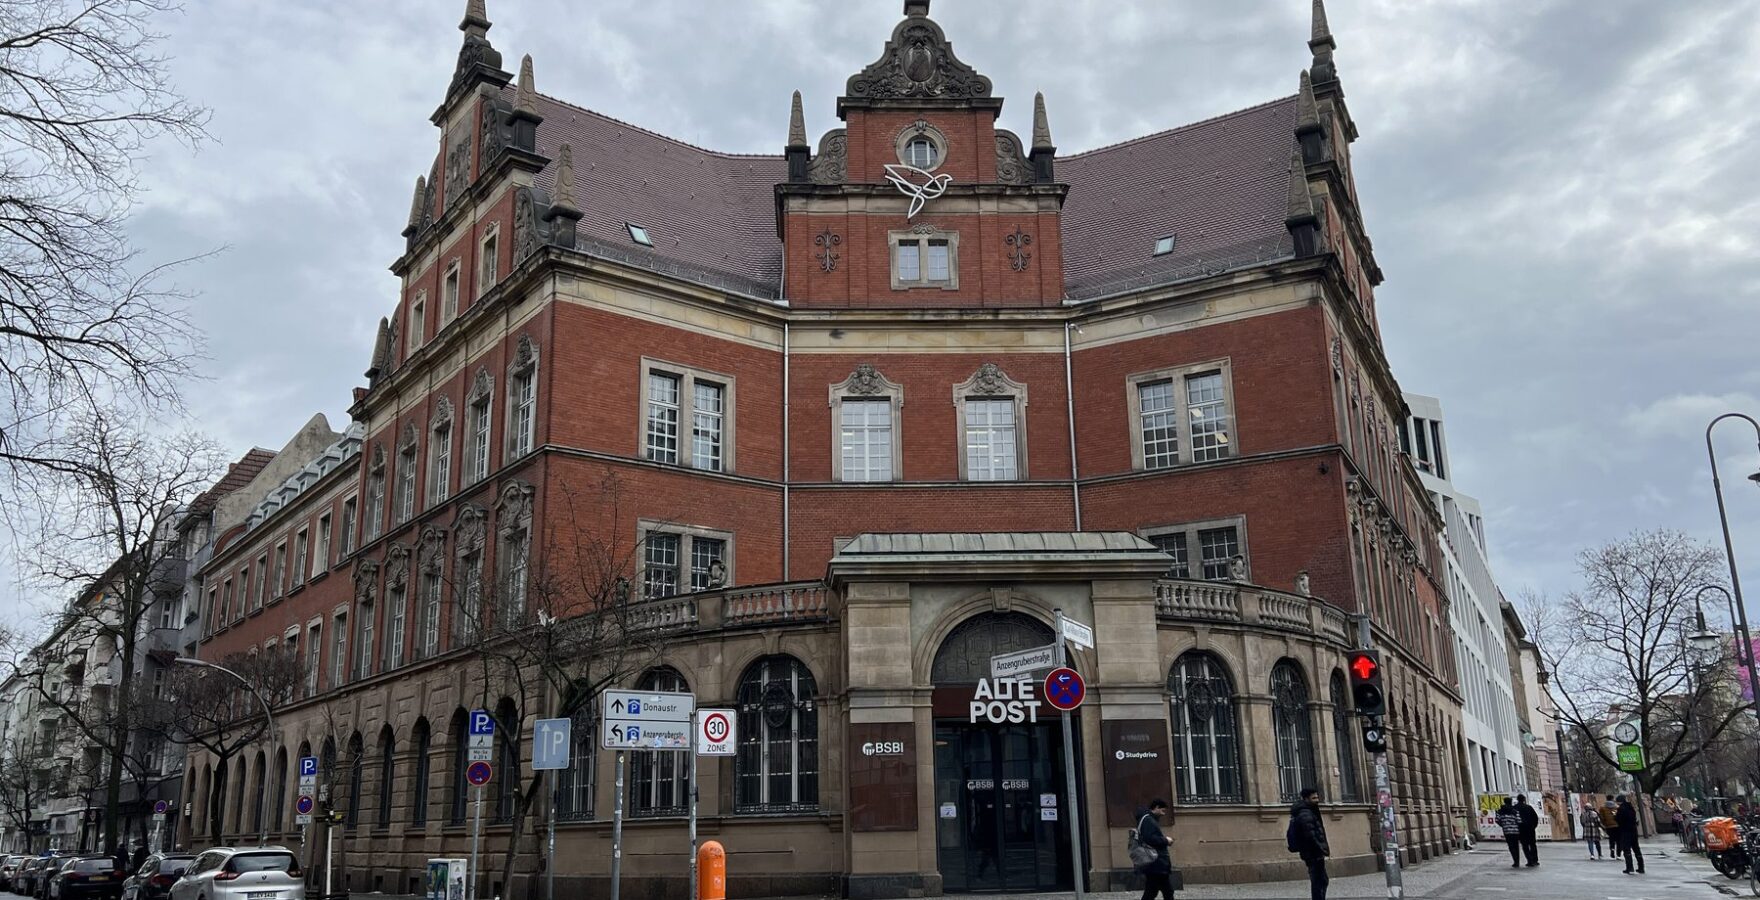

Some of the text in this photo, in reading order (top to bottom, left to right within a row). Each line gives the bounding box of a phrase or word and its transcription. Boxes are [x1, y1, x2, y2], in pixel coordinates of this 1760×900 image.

[997, 652, 1051, 671] Anzengruberstraße
[974, 678, 1035, 700] ALTE
[970, 700, 1042, 724] POST
[474, 714, 489, 733] P
[709, 721, 725, 735] 30
[553, 731, 564, 756] P
[876, 742, 904, 753] BSBI
[304, 760, 313, 775] P
[976, 781, 994, 789] BSBI
[1011, 781, 1029, 789] BSBI
